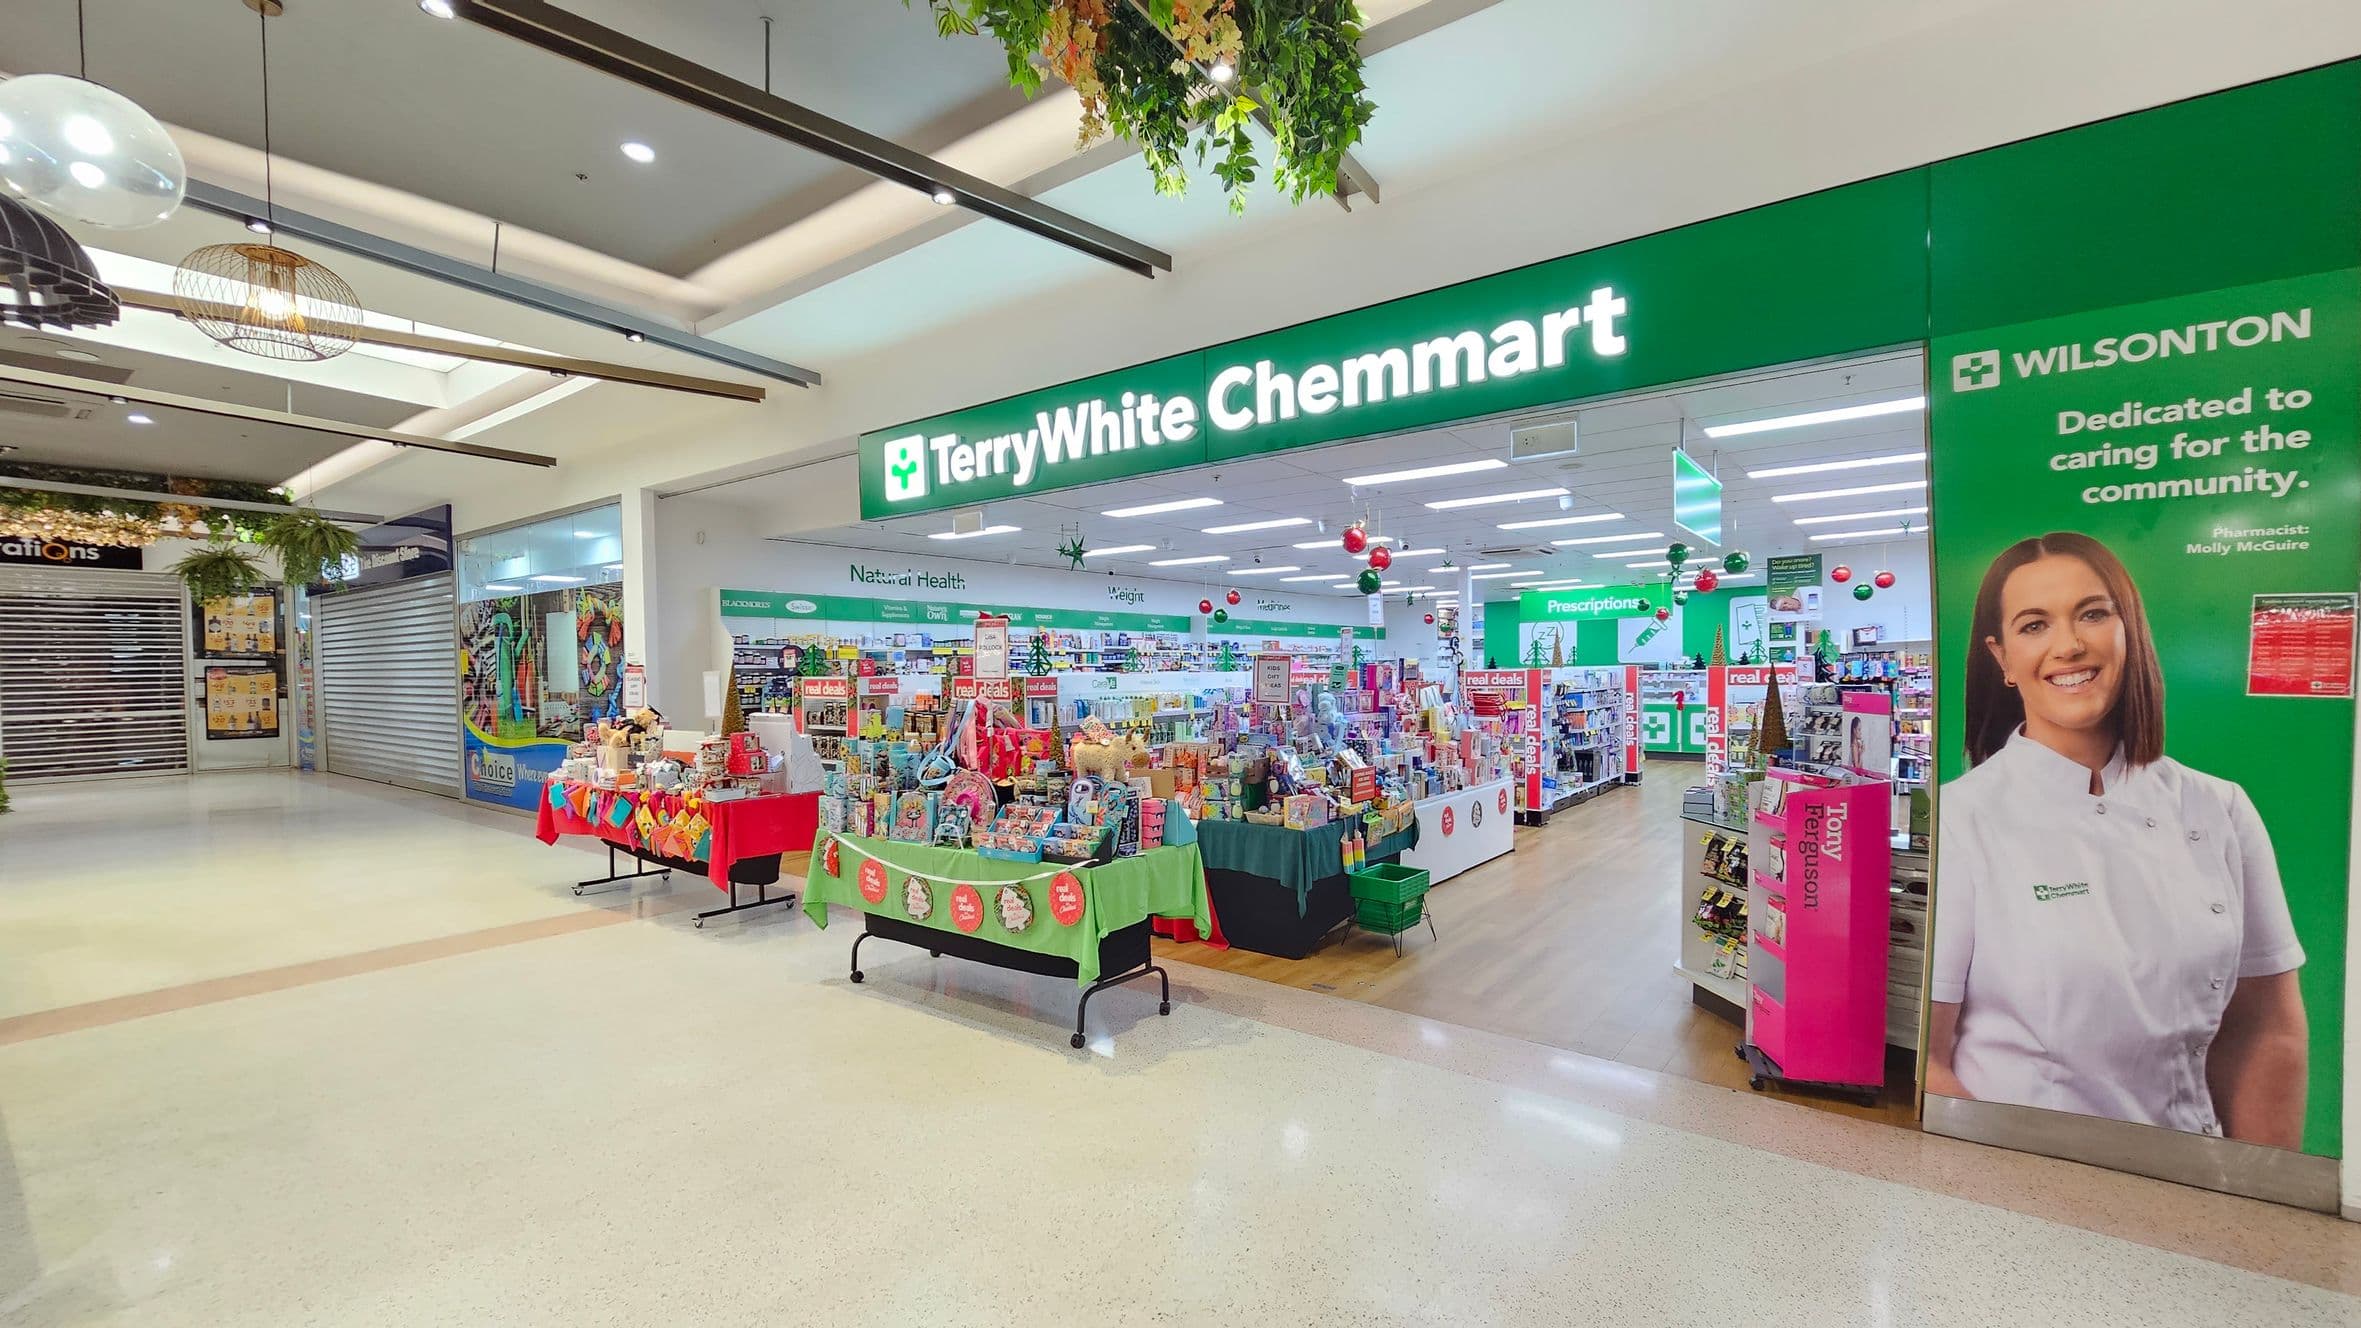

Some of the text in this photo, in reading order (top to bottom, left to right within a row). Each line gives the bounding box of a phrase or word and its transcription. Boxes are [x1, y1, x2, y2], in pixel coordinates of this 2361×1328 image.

[2012, 308, 2311, 378] WILSONTON
[929, 286, 1627, 487] TerryWhite Chemmart
[2058, 387, 2312, 435] Dedicated to
[2050, 424, 2312, 470] caring for the
[2082, 467, 2309, 504] community.
[2212, 524, 2309, 538] Pharmacist:
[2186, 540, 2309, 556] Molly McGuire
[850, 564, 966, 590] Natural Health
[721, 599, 771, 608] BLACKMORES
[1108, 586, 1145, 605] Weight
[1547, 596, 1639, 615] Prescriptions
[805, 681, 846, 695] real deals
[869, 681, 898, 690] real deals
[956, 681, 1009, 698] real deals
[1026, 681, 1057, 692] real deals
[1467, 674, 1523, 686] real deals
[1729, 670, 1760, 684] real
[1626, 692, 1638, 746] real deals
[1708, 707, 1725, 737] real
[1527, 704, 1540, 775] real deals
[471, 752, 513, 780] Choice
[1821, 802, 1848, 861] Tony
[1798, 803, 1824, 910] Ferguson
